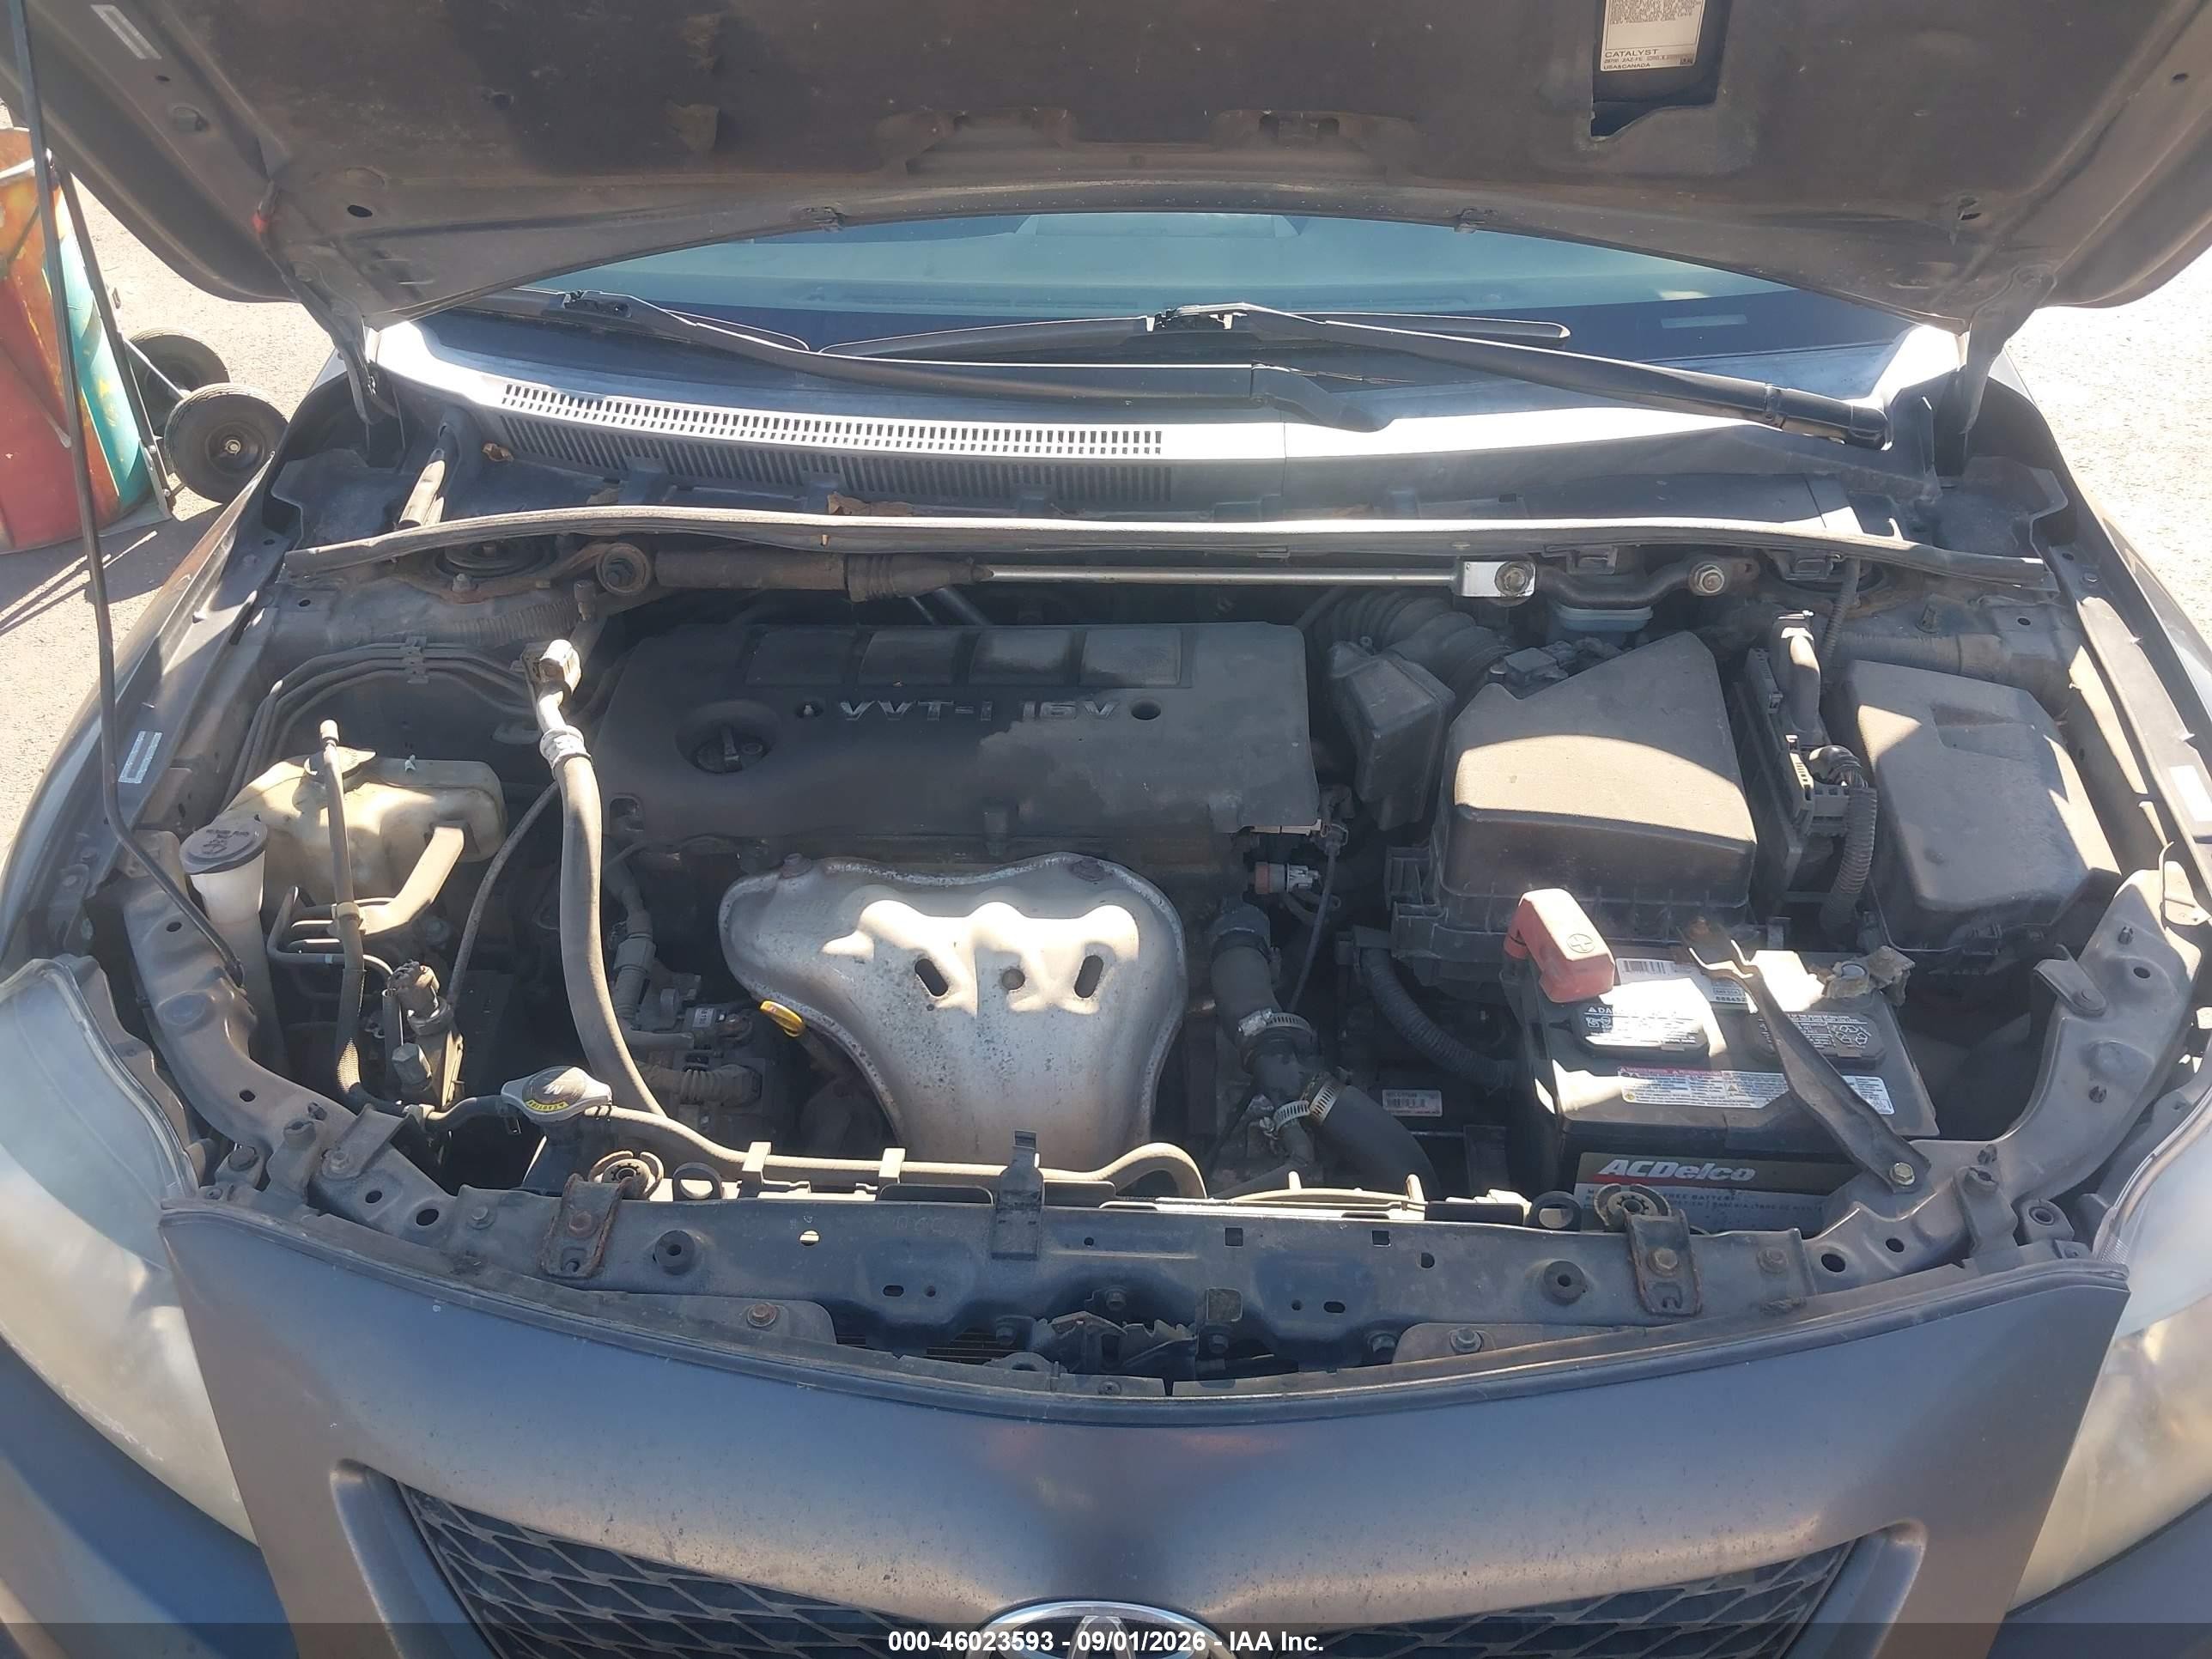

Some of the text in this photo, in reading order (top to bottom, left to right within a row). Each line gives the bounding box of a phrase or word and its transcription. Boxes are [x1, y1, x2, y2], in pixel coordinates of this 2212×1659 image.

[1605, 49, 1659, 58] CATALYST
[1022, 700, 1116, 722] 16V
[1598, 1159, 1756, 1181] ACDelco
